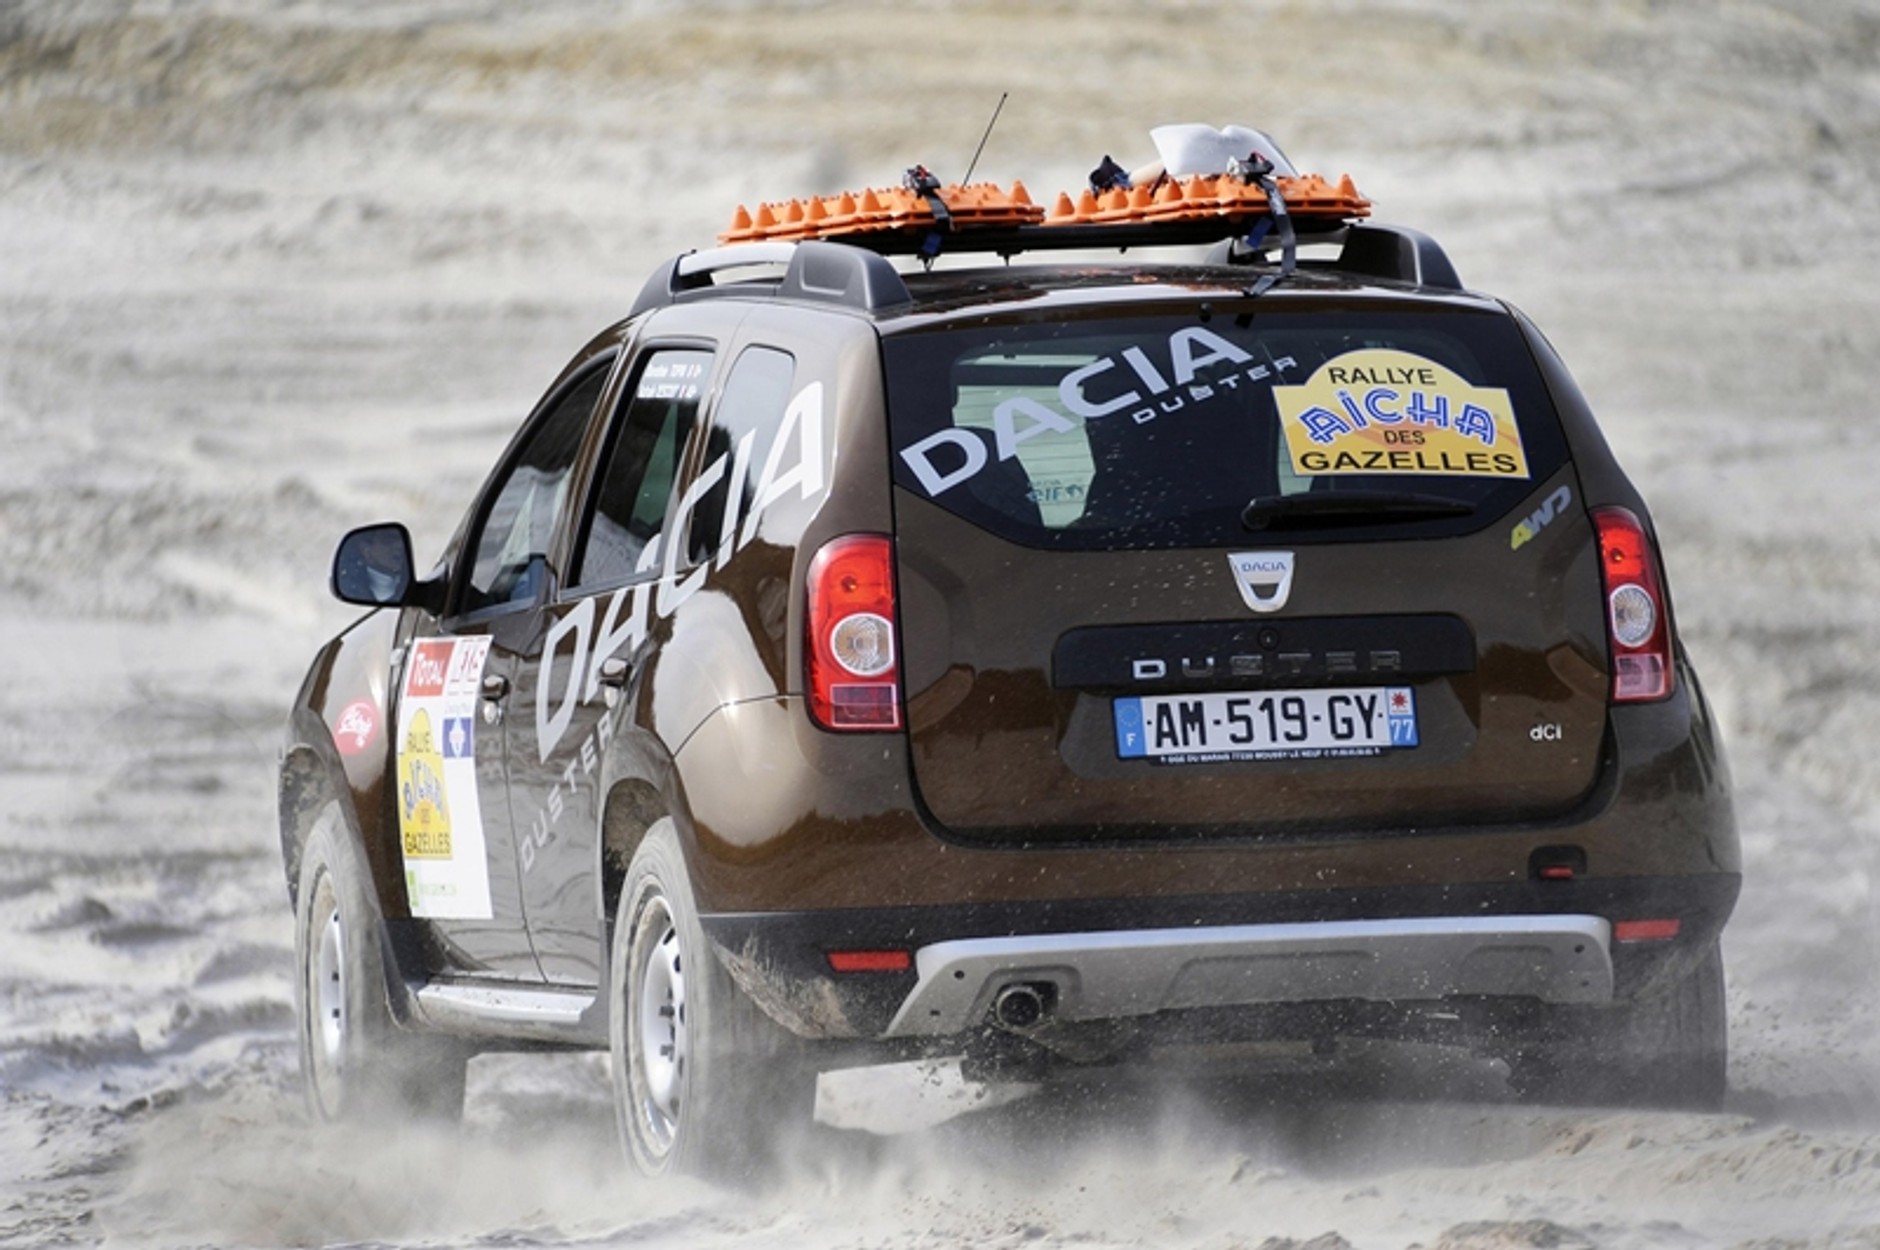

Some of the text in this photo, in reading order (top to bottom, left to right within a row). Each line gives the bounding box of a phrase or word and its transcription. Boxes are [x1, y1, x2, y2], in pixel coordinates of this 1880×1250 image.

[1328, 367, 1437, 386] RALLYE
[1133, 356, 1299, 425] DUSTER
[900, 325, 1254, 498] DACIA
[1383, 430, 1426, 446] DES
[1300, 451, 1518, 474] GAZELLES
[1510, 485, 1572, 551] 4WD
[535, 380, 824, 764] DACIA
[1241, 561, 1287, 573] DACIA
[1132, 651, 1402, 680] DUSTER
[1126, 732, 1136, 747] F
[1390, 719, 1414, 741] 77
[520, 712, 615, 876] DUSTER
